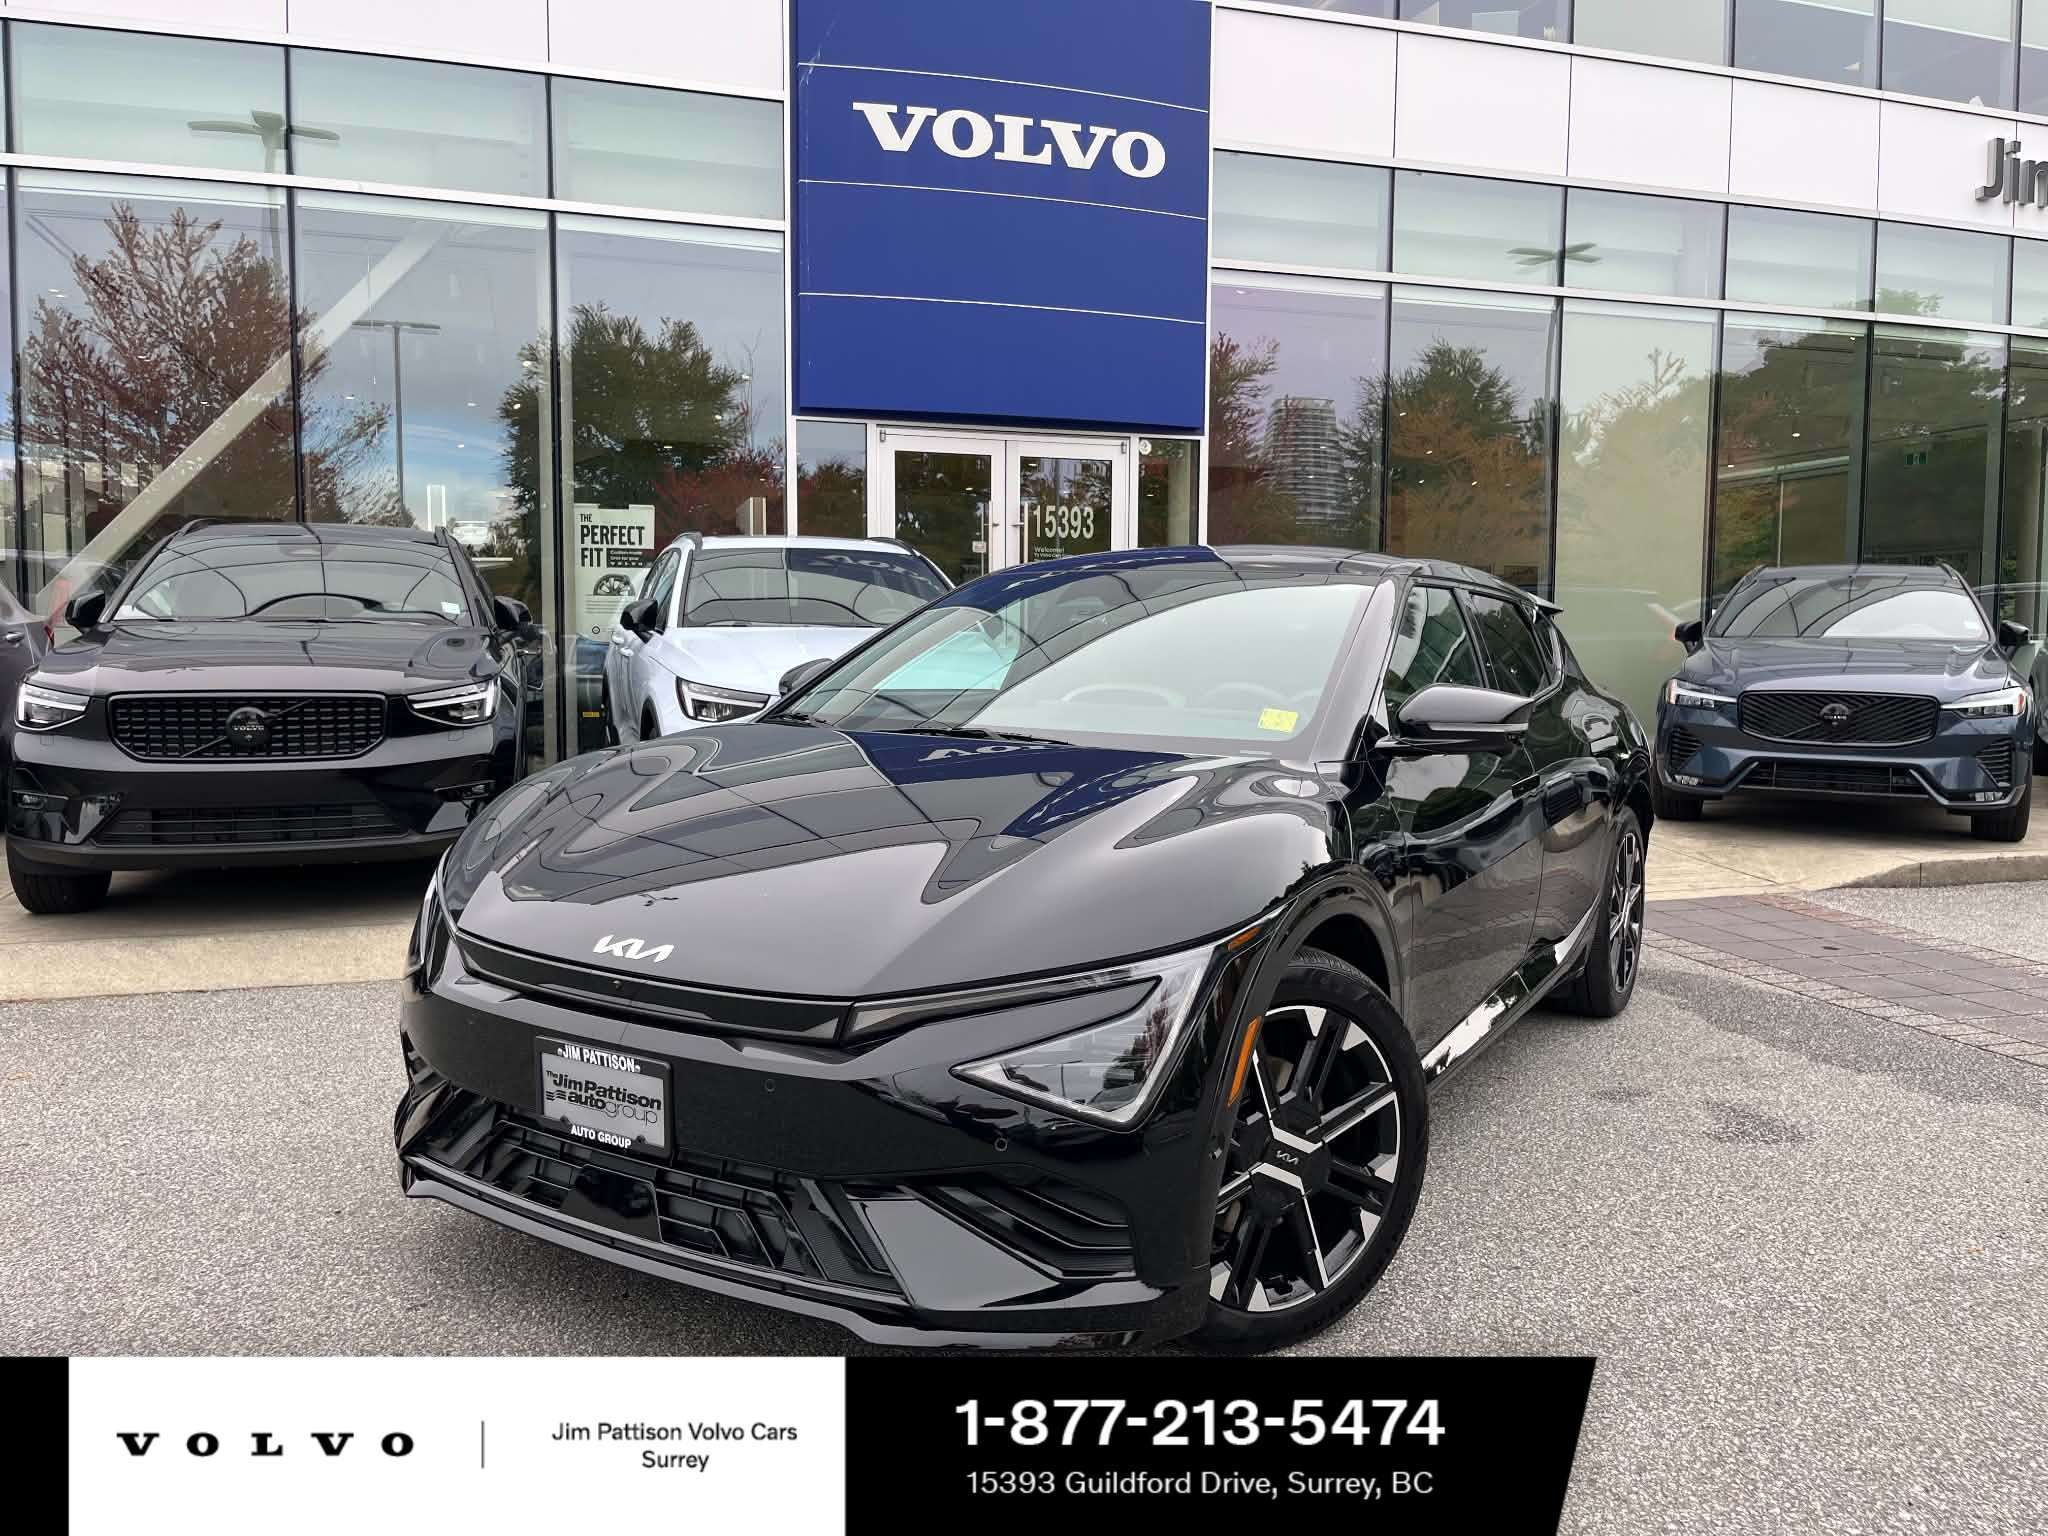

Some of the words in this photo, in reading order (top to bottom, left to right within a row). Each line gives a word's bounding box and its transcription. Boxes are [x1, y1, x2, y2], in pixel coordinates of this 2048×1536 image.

[853, 102, 1166, 178] VOLVO
[580, 513, 593, 523] THE
[1033, 505, 1095, 538] 15393
[580, 525, 645, 546] PERFECT
[580, 547, 604, 568] FIT
[593, 935, 674, 963] KIA
[562, 1045, 582, 1061] JIM
[583, 1049, 635, 1073] PATTISON
[571, 1125, 596, 1141] AUTO
[597, 1131, 632, 1149] GROUP
